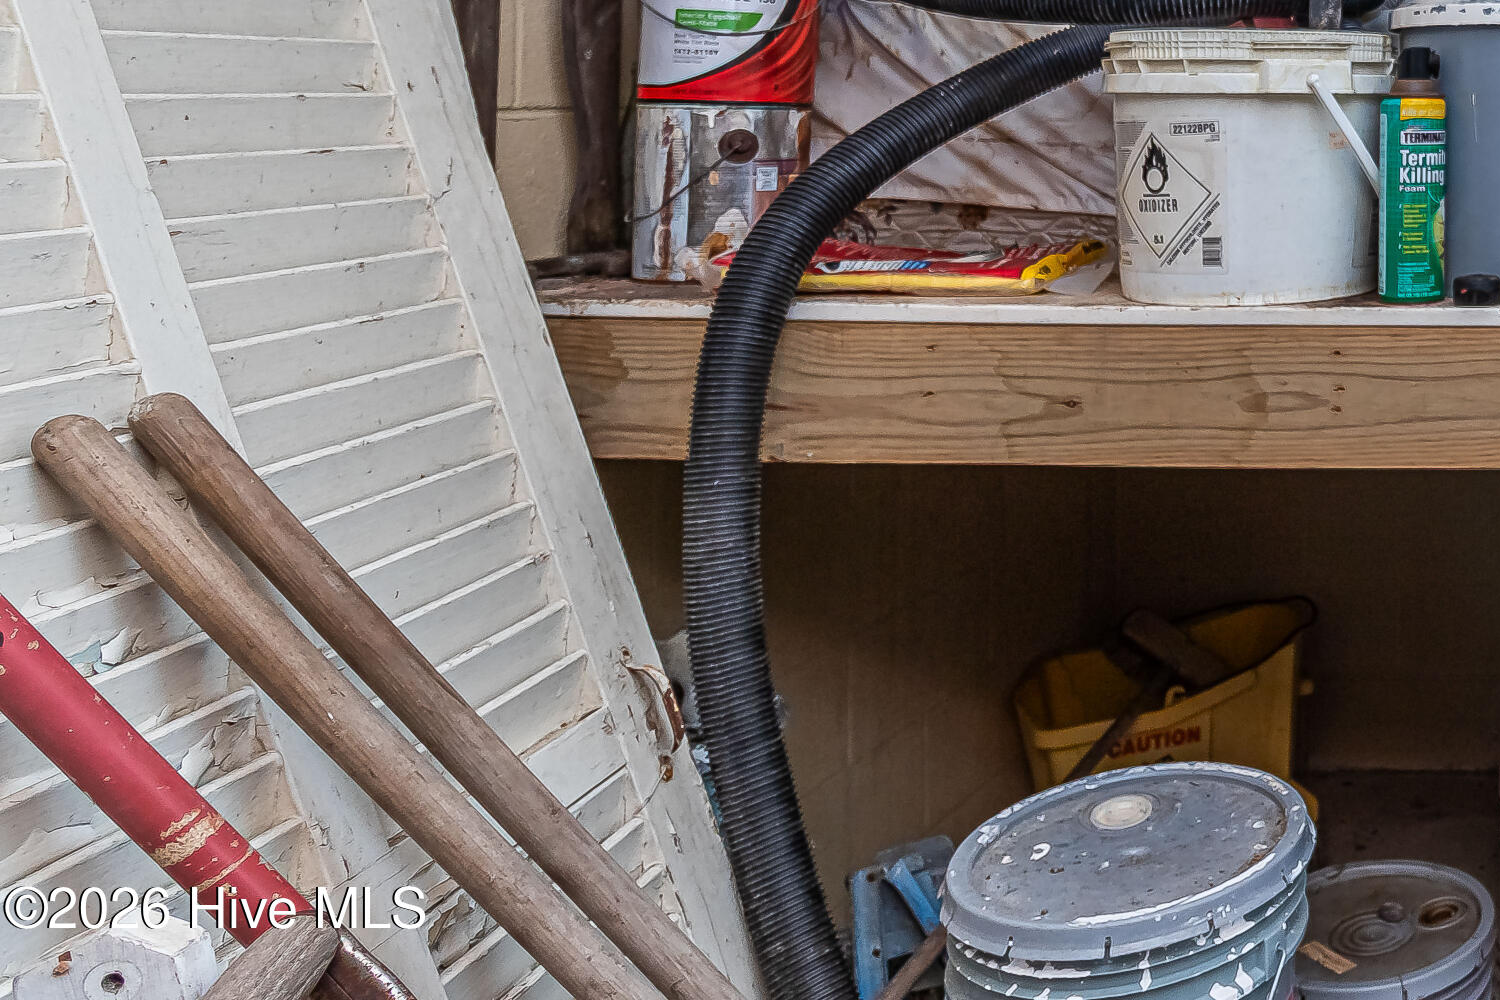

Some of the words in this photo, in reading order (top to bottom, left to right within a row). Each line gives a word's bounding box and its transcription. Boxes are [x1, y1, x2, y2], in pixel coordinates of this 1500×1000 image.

[1399, 165, 1445, 186] Killing
[1399, 184, 1425, 192] Foam
[1138, 199, 1178, 213] OXIDIZER
[1106, 726, 1201, 759] CAUTION
